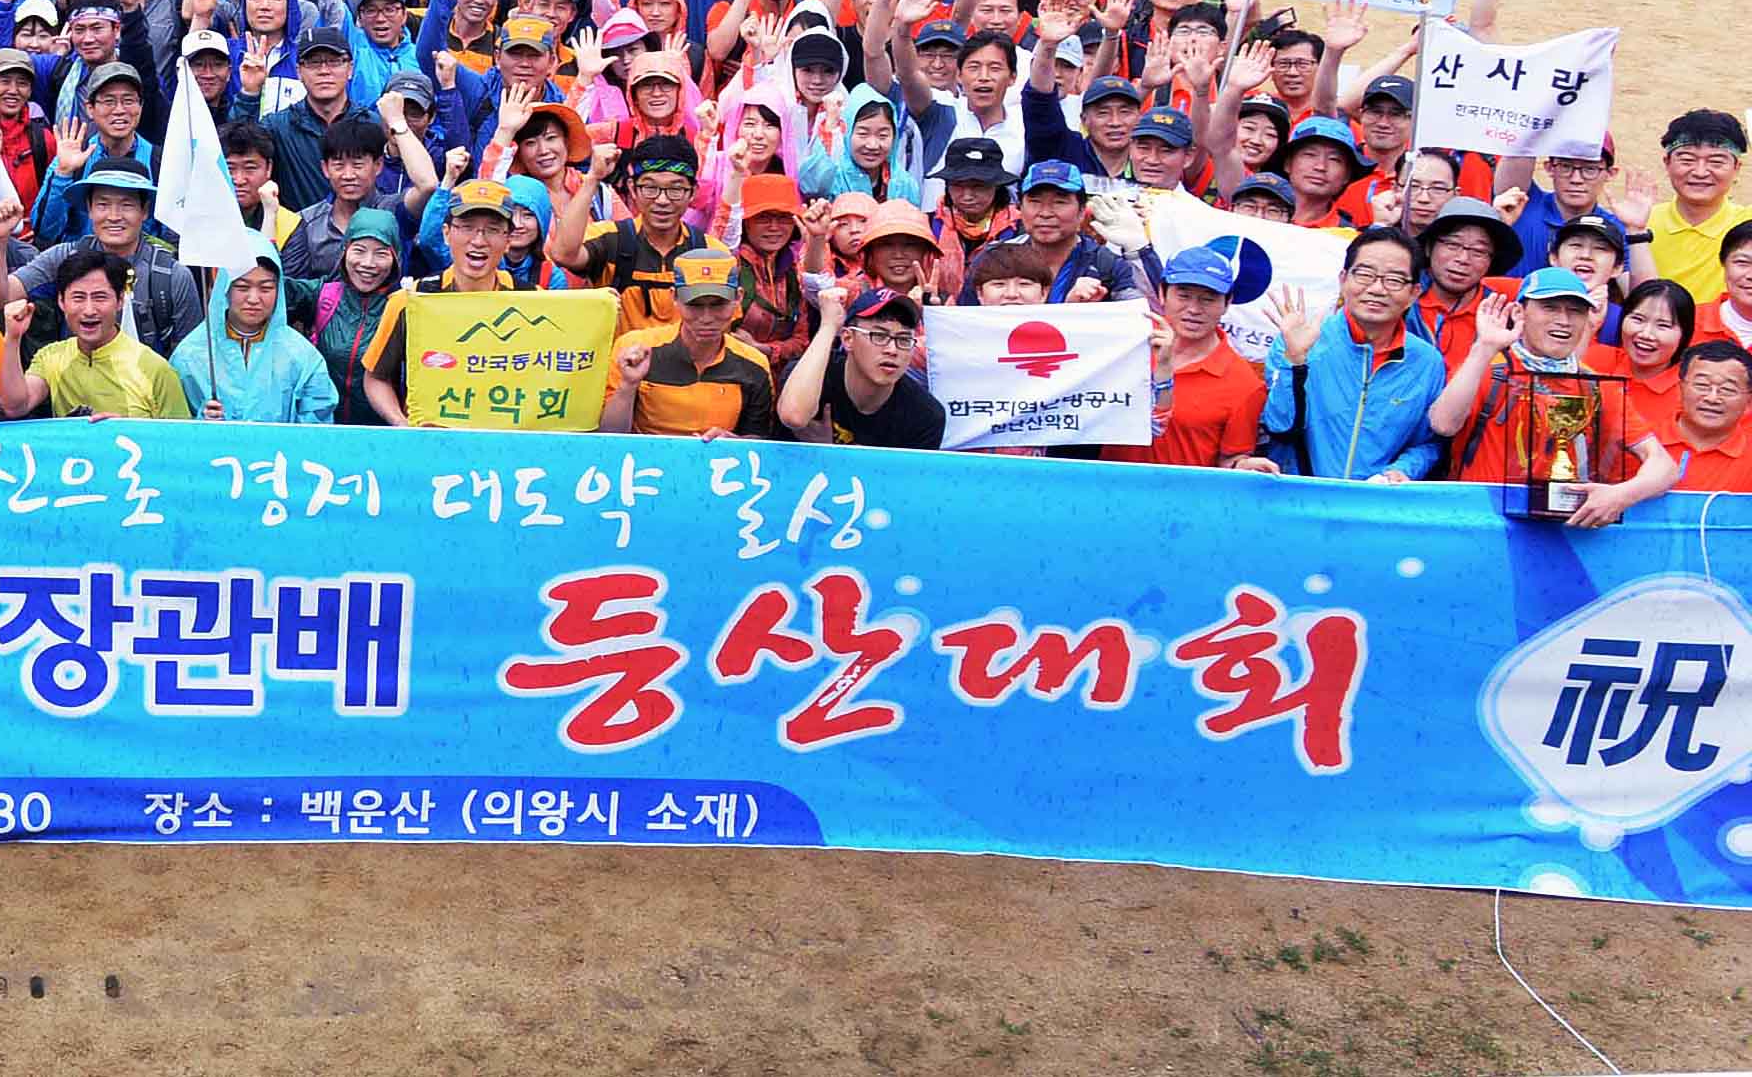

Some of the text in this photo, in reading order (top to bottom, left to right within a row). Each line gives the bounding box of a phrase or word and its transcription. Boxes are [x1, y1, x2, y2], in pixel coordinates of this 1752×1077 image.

[1455, 103, 1554, 130] 한국디자인진흥원
[467, 350, 596, 374] 한국동서발전
[438, 385, 571, 424] 산악회
[211, 451, 382, 527] 경제
[431, 455, 664, 549] 대도약
[707, 450, 870, 560] 달성
[504, 569, 1358, 770] 등산대회
[1541, 637, 1735, 773] 祝
[143, 789, 234, 836] 장소
[299, 790, 436, 836] 백운산
[460, 788, 621, 838] (의왕시
[645, 788, 761, 839] 소재)
